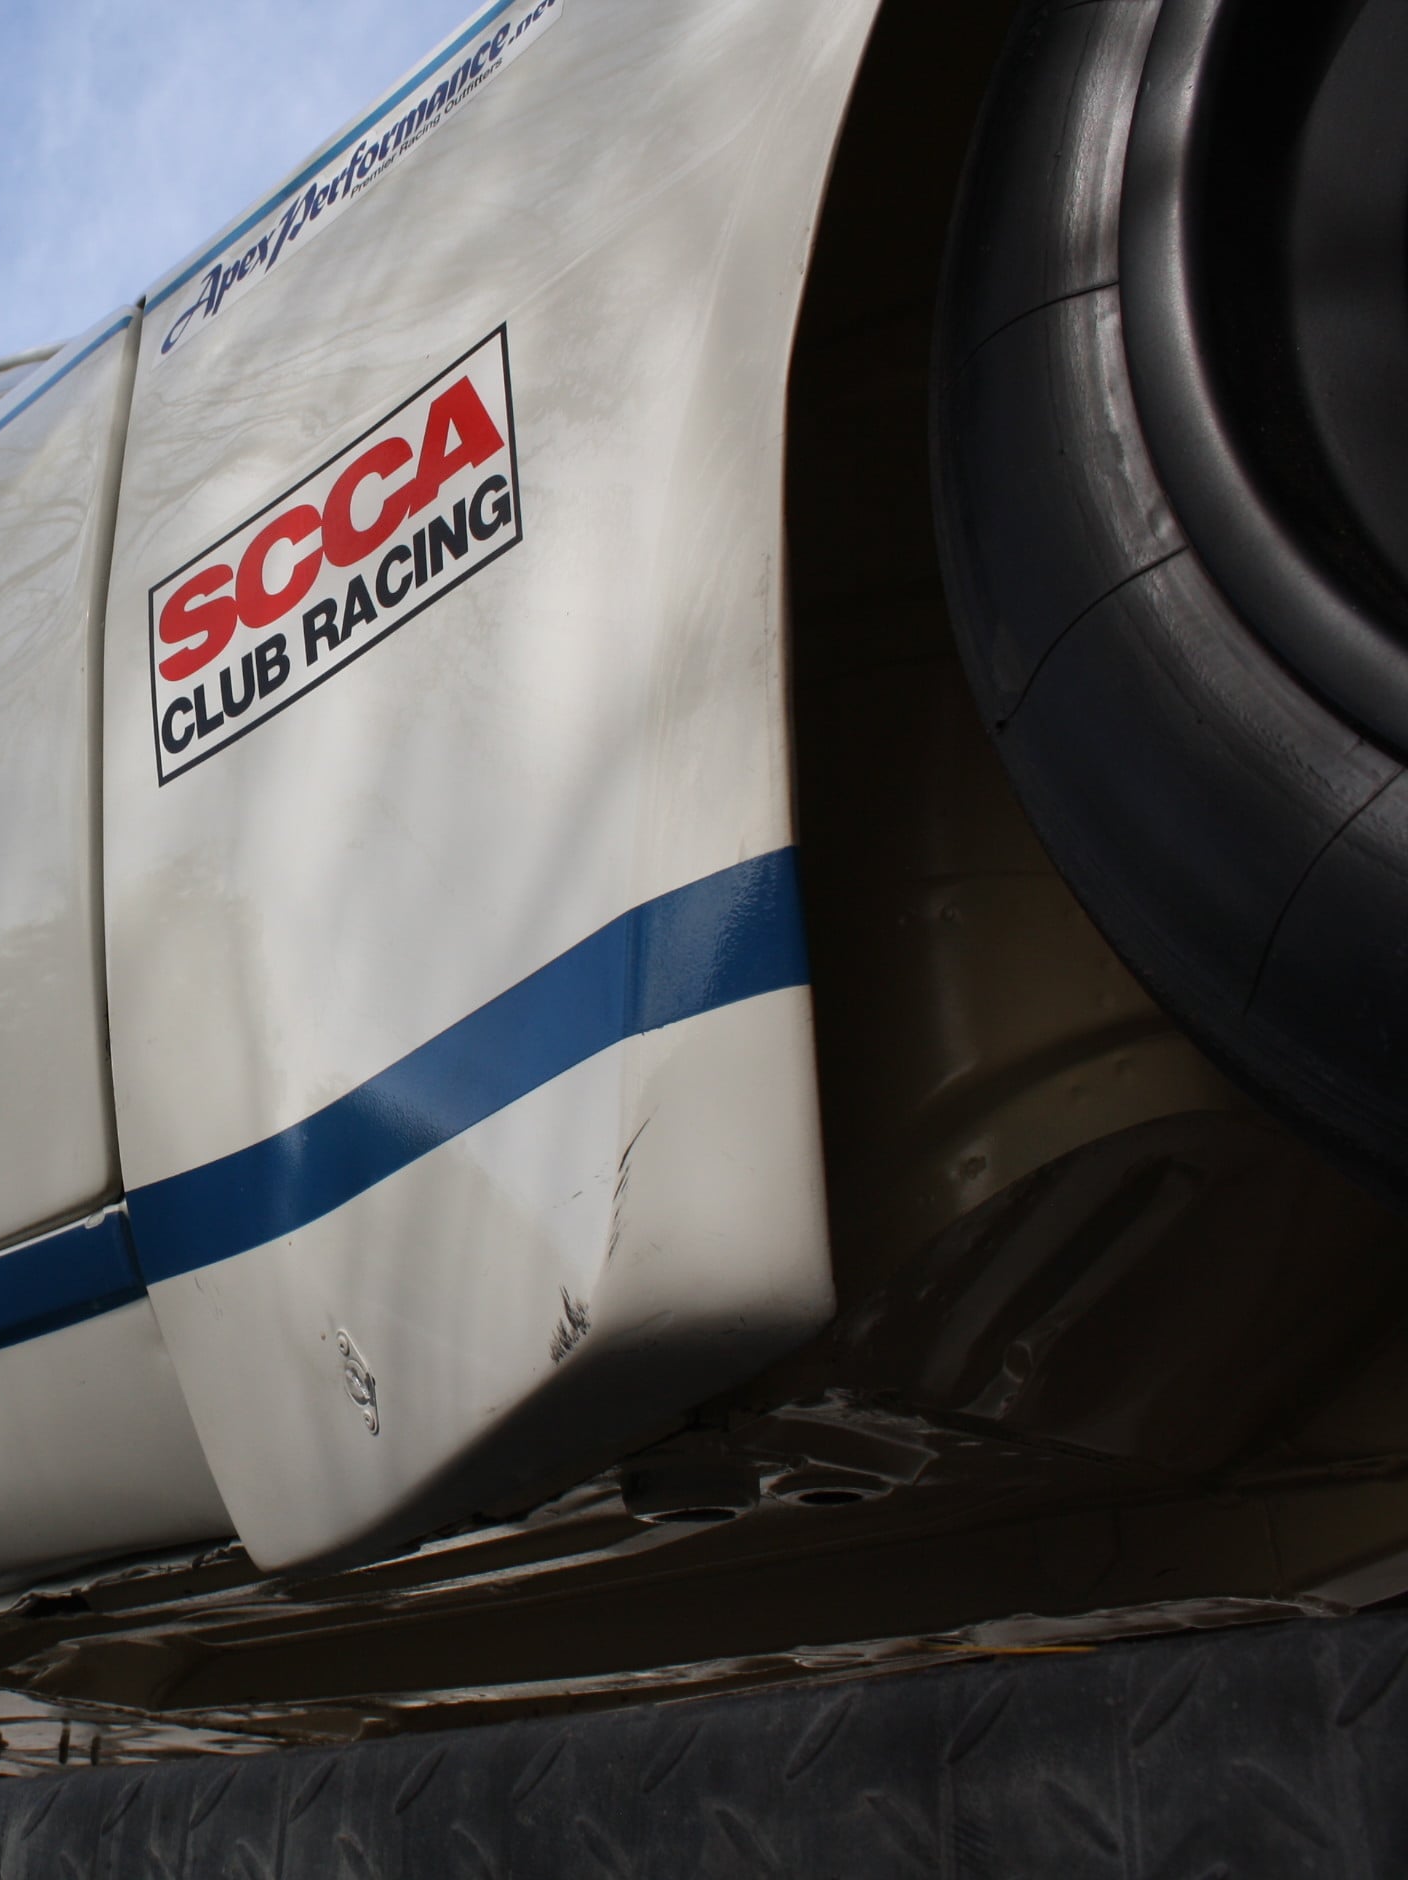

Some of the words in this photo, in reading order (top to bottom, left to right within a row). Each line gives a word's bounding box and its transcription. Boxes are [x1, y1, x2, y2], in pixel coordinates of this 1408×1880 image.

[350, 155, 396, 198] Premier
[399, 113, 442, 154] Racing
[444, 57, 503, 114] Outfitters
[158, 375, 505, 682] SCCA
[160, 633, 291, 754] CLUB
[302, 474, 512, 667] RACING
